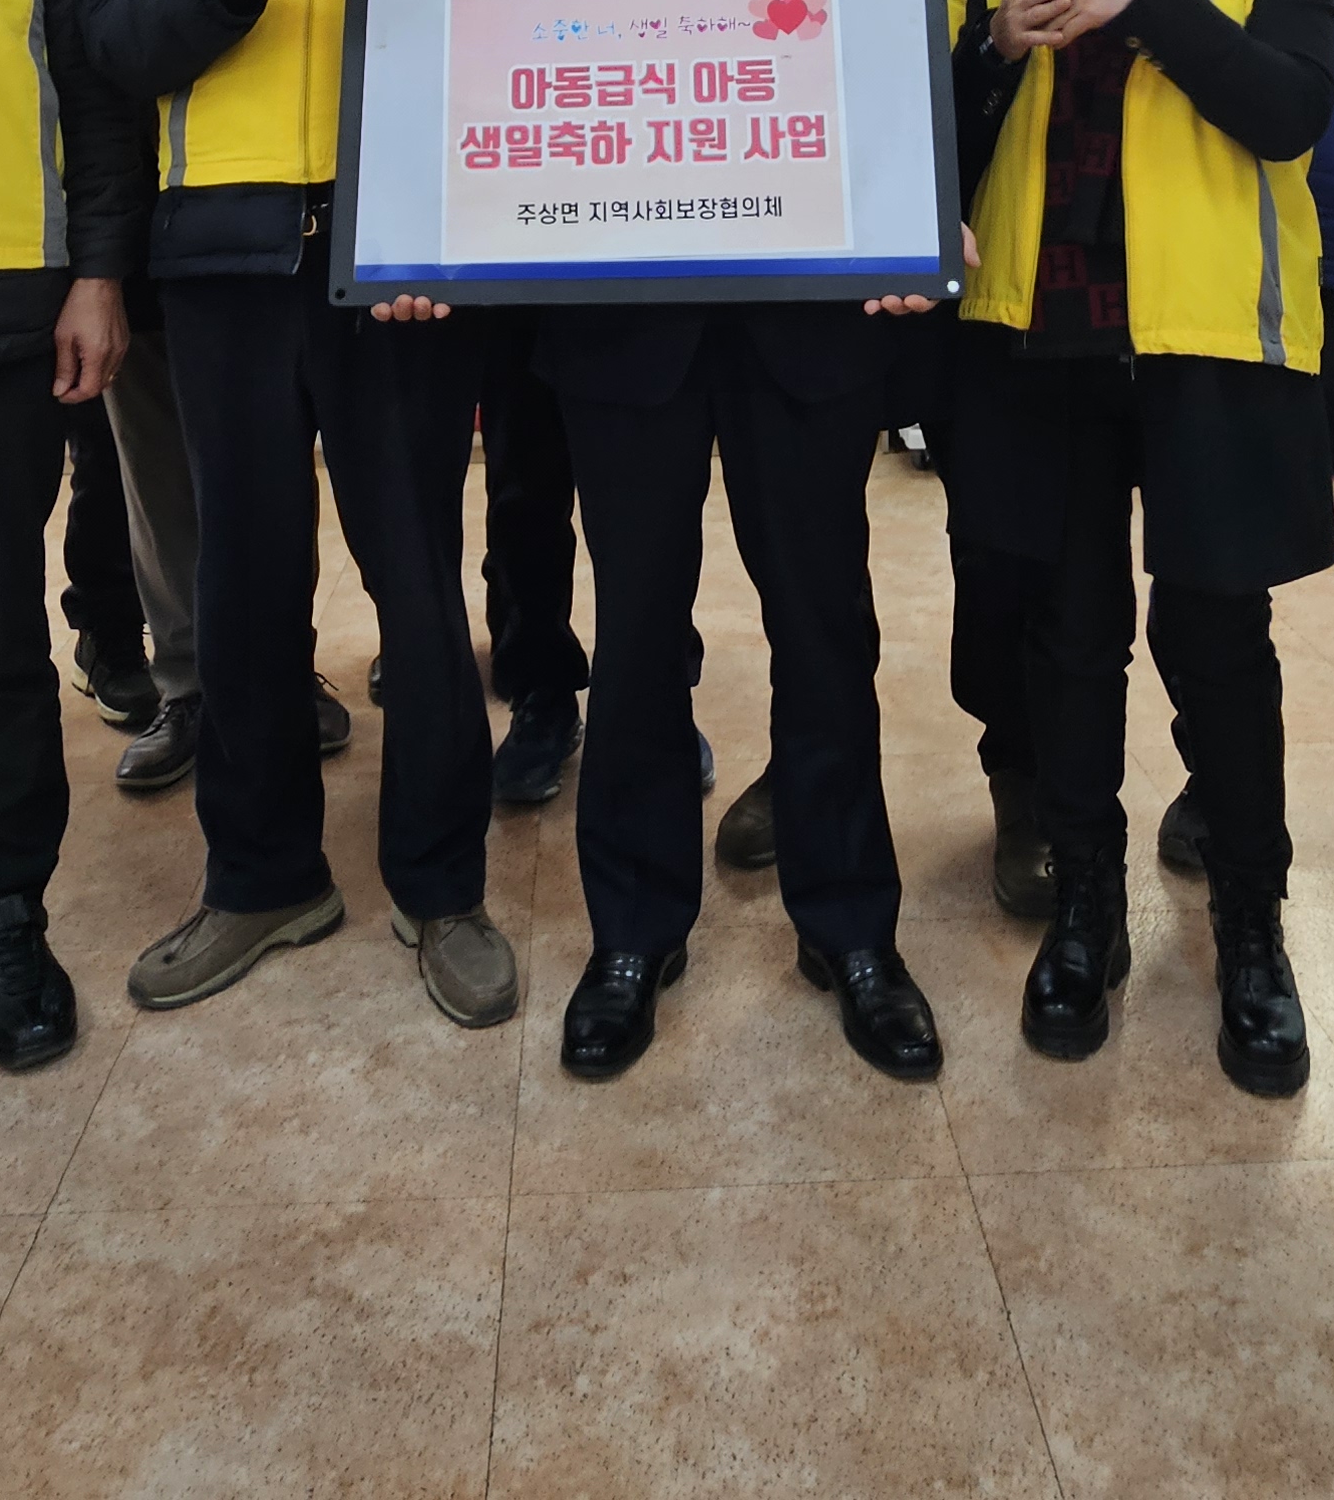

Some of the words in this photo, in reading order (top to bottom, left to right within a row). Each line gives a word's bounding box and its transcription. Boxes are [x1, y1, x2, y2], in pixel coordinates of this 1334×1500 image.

[532, 18, 589, 41] 소중한
[629, 16, 668, 39] 생일
[511, 62, 677, 110] 아동급식
[693, 59, 776, 104] 아동
[460, 120, 633, 169] 생일축하
[646, 117, 728, 163] 지원
[744, 114, 827, 161] 사업
[516, 202, 580, 225] 주상면
[588, 195, 783, 222] 지역사회보장협의체
